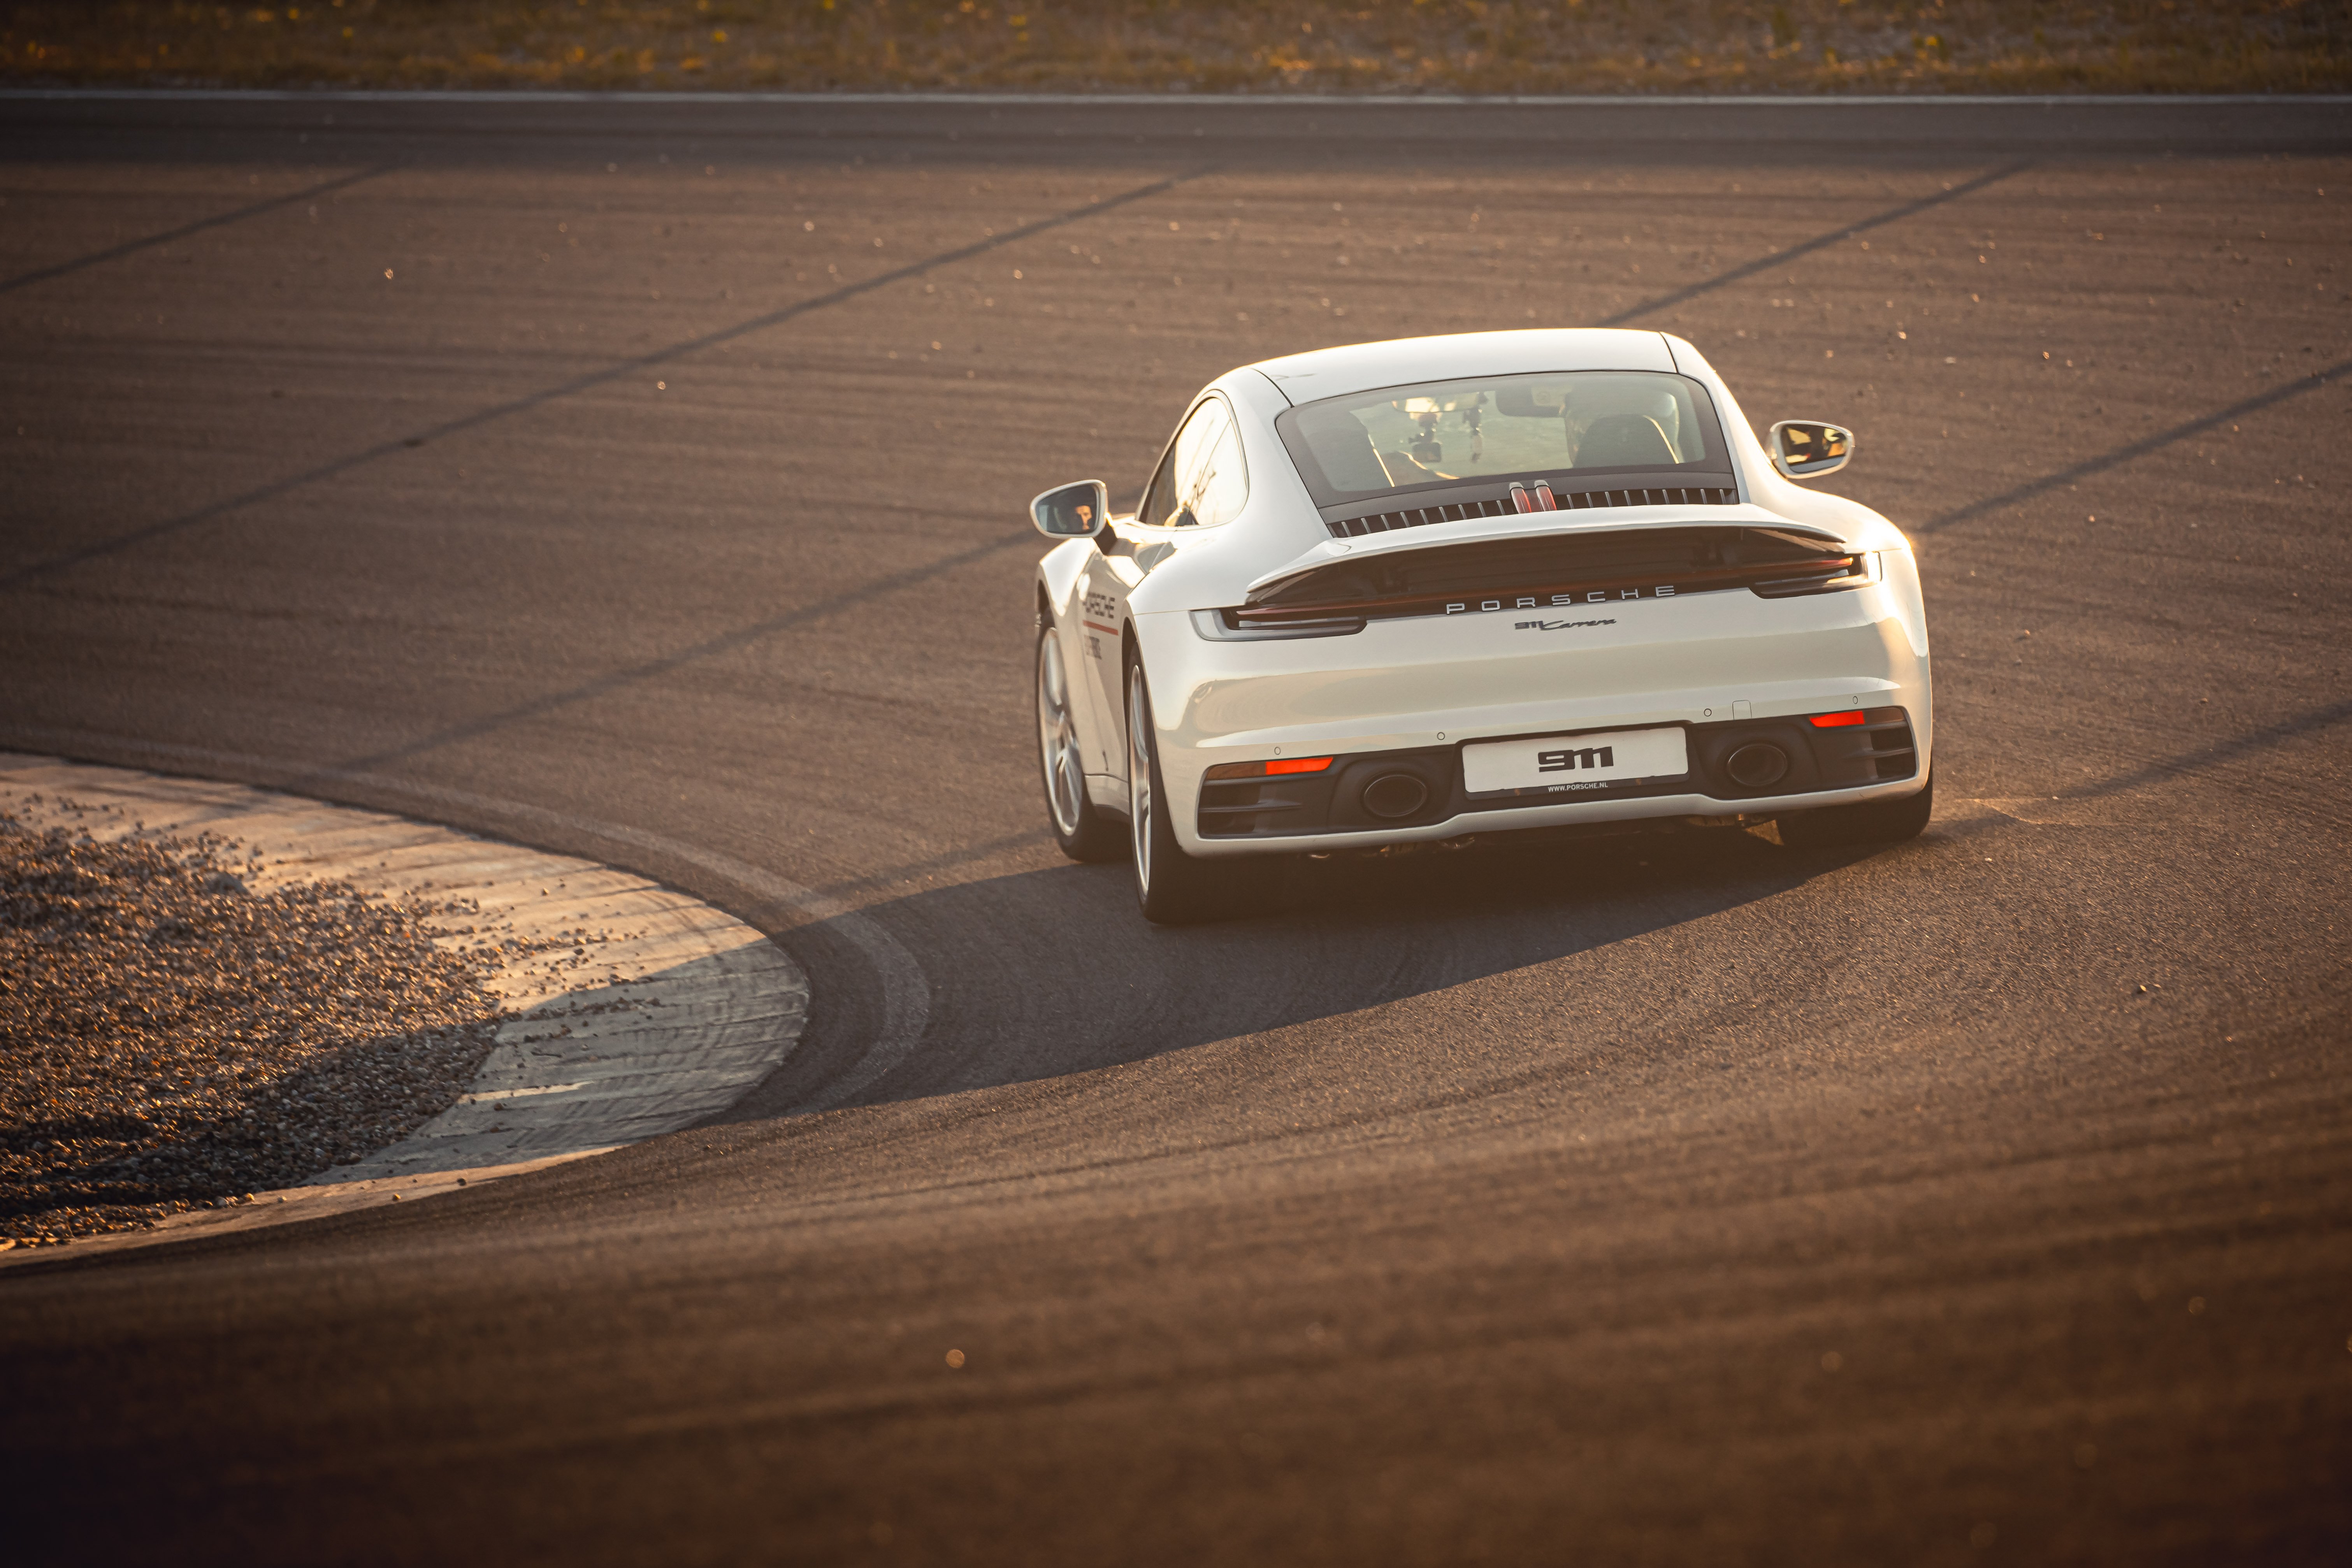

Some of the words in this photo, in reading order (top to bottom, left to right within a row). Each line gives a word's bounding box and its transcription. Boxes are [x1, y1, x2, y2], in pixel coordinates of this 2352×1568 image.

[1446, 585, 1675, 614] PORSCHE
[1515, 620, 1543, 630] 911
[1538, 746, 1614, 773] 911
[1548, 782, 1608, 792] WWW.PORSCHE.NL
